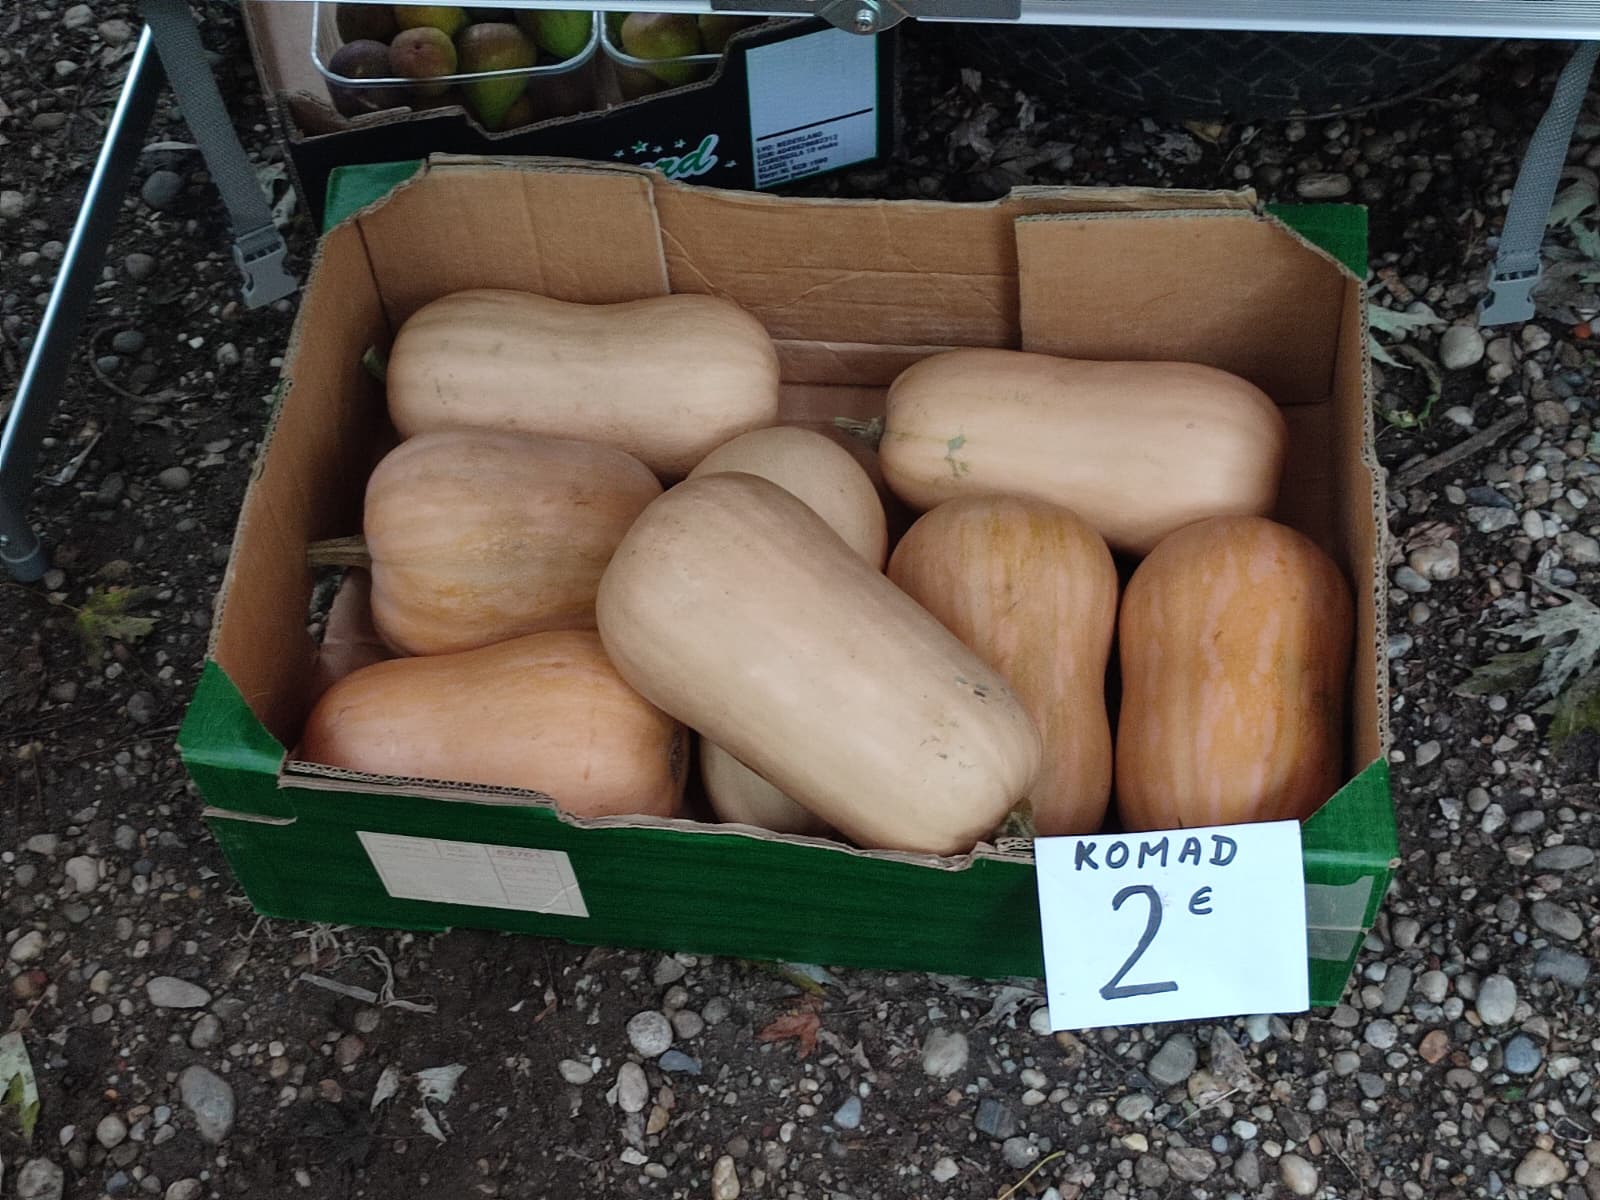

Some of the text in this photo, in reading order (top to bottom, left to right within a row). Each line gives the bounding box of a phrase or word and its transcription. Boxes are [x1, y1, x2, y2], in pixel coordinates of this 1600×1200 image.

[1074, 834, 1238, 871] KOMAD
[1098, 884, 1213, 1001] 2 €
